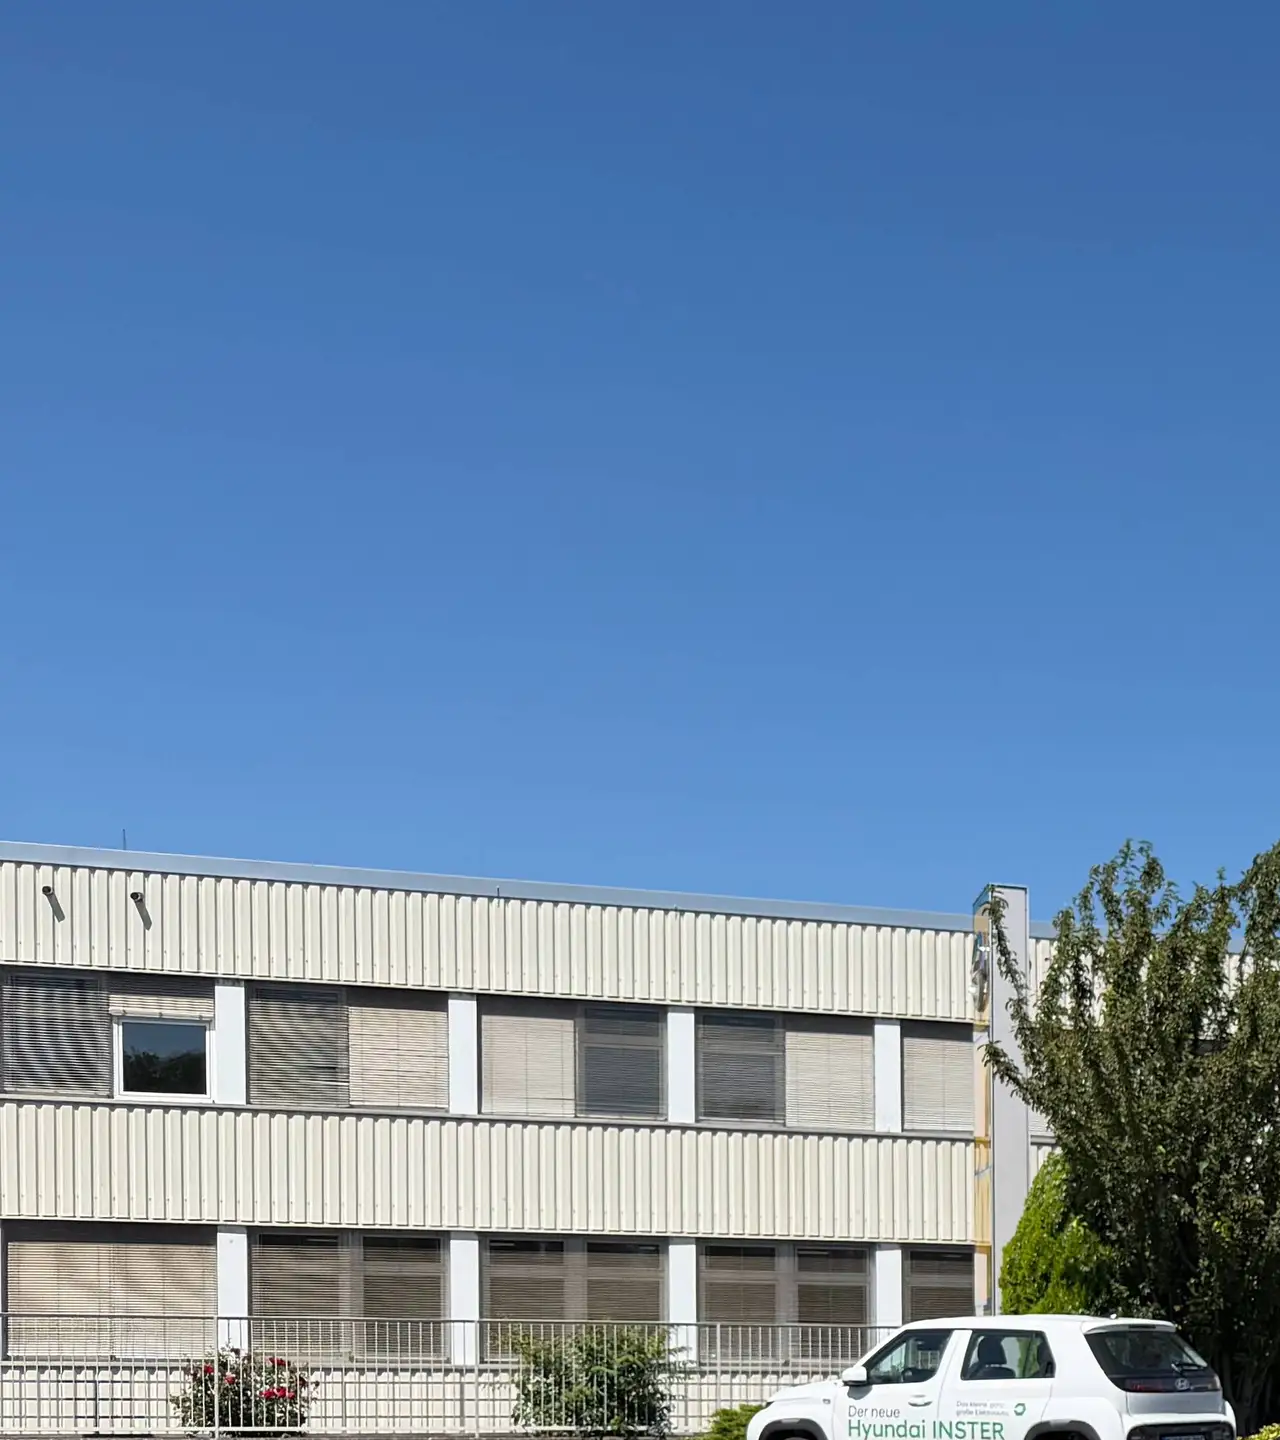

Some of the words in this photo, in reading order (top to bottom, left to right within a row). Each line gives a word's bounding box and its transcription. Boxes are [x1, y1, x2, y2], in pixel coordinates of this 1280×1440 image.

[848, 1405, 867, 1418] Der
[871, 1407, 900, 1418] neue
[933, 1420, 1005, 1440] INSTER
